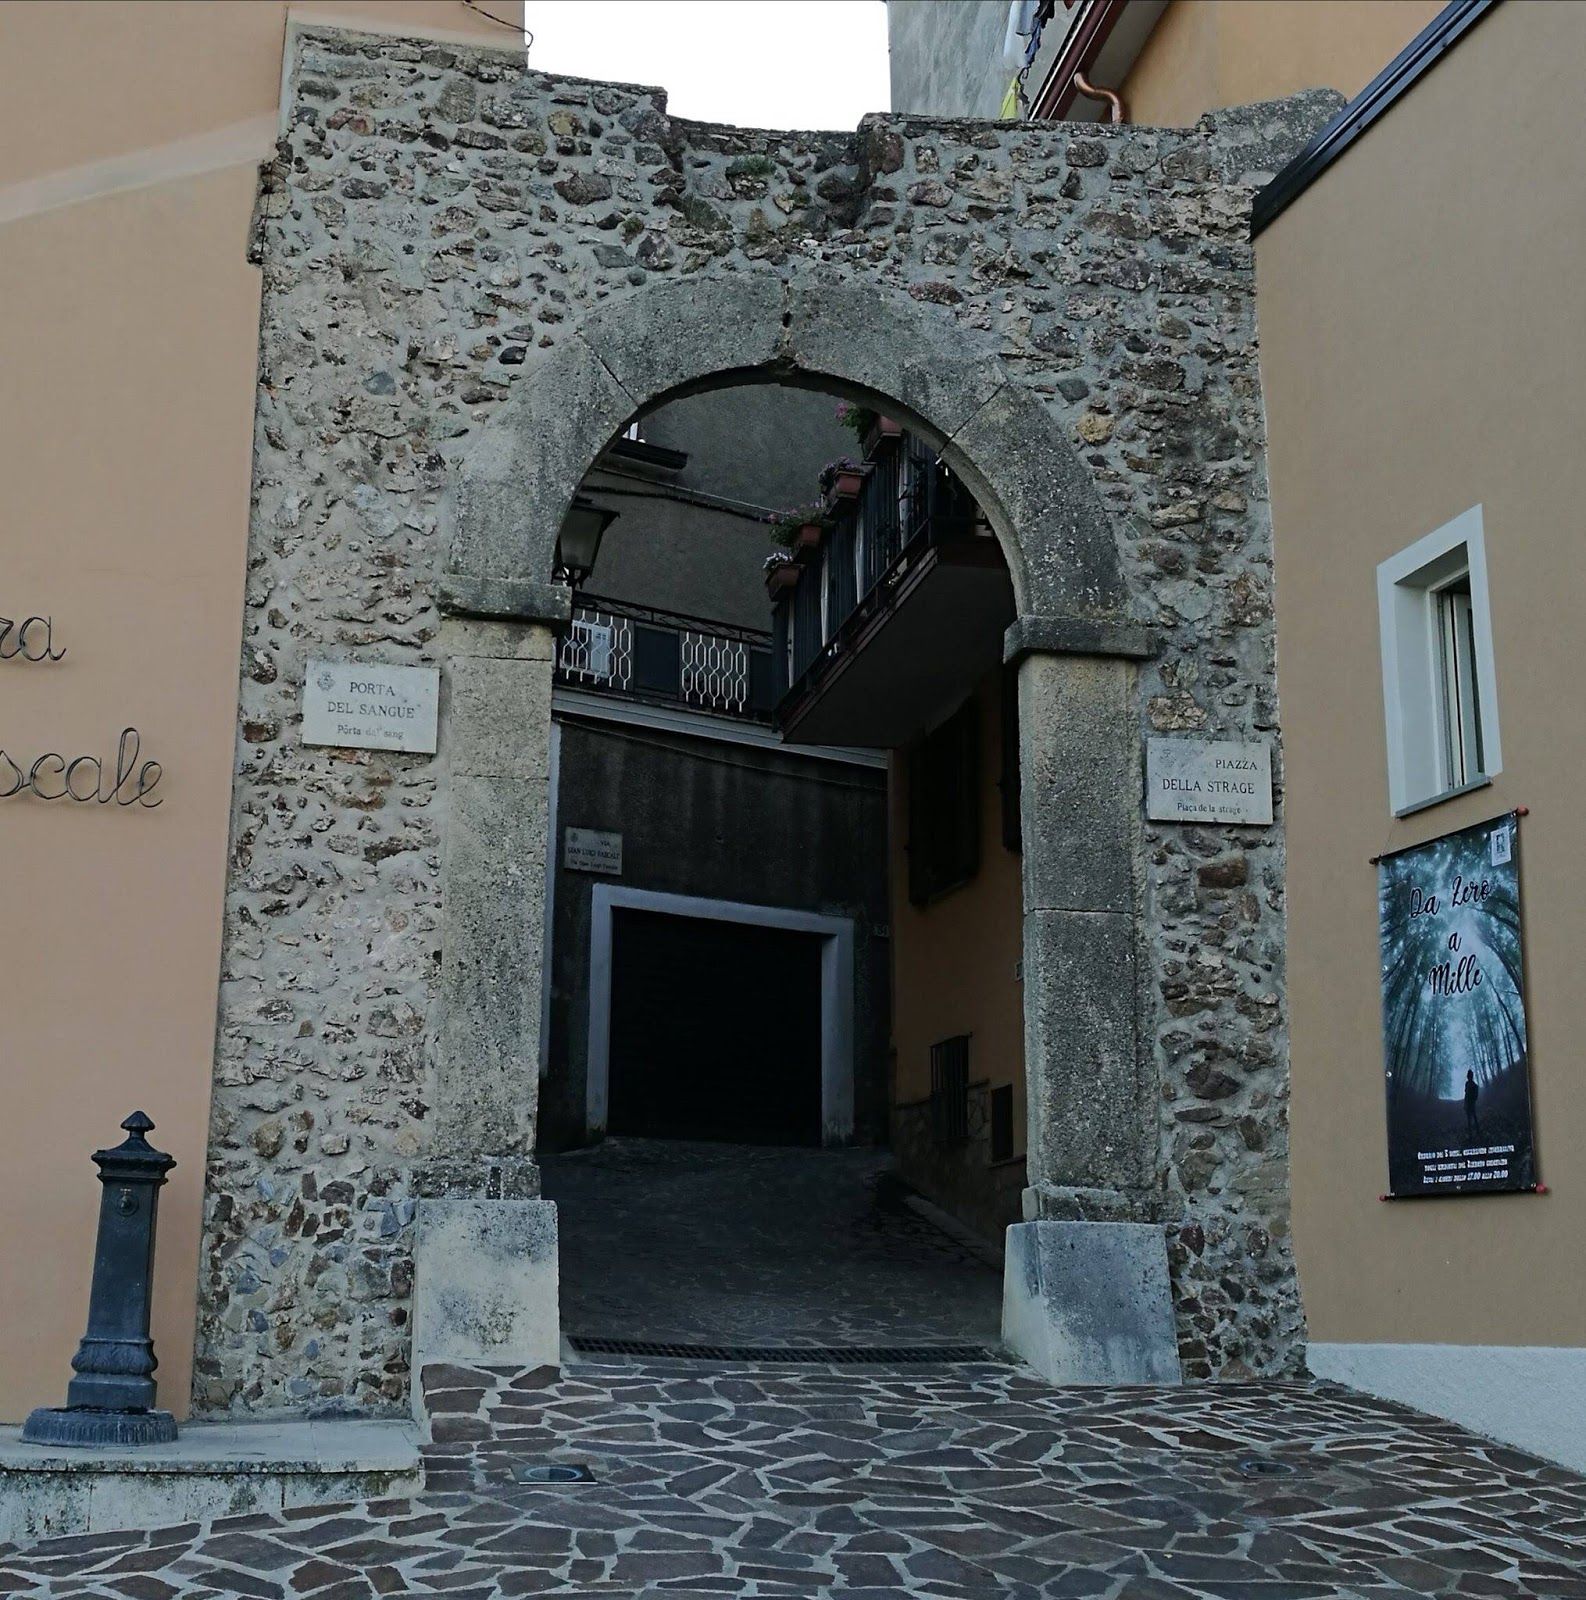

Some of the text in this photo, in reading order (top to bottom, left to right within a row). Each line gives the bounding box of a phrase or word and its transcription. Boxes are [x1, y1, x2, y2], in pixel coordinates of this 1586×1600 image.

[349, 681, 395, 697] PORTA
[327, 701, 415, 719] DEL SANGUE
[1215, 759, 1258, 771] PIAZZA
[1162, 778, 1255, 794] DELLA STRAGE
[1452, 875, 1492, 907] Zero
[1447, 931, 1462, 952] a
[1428, 953, 1484, 996] Mille
